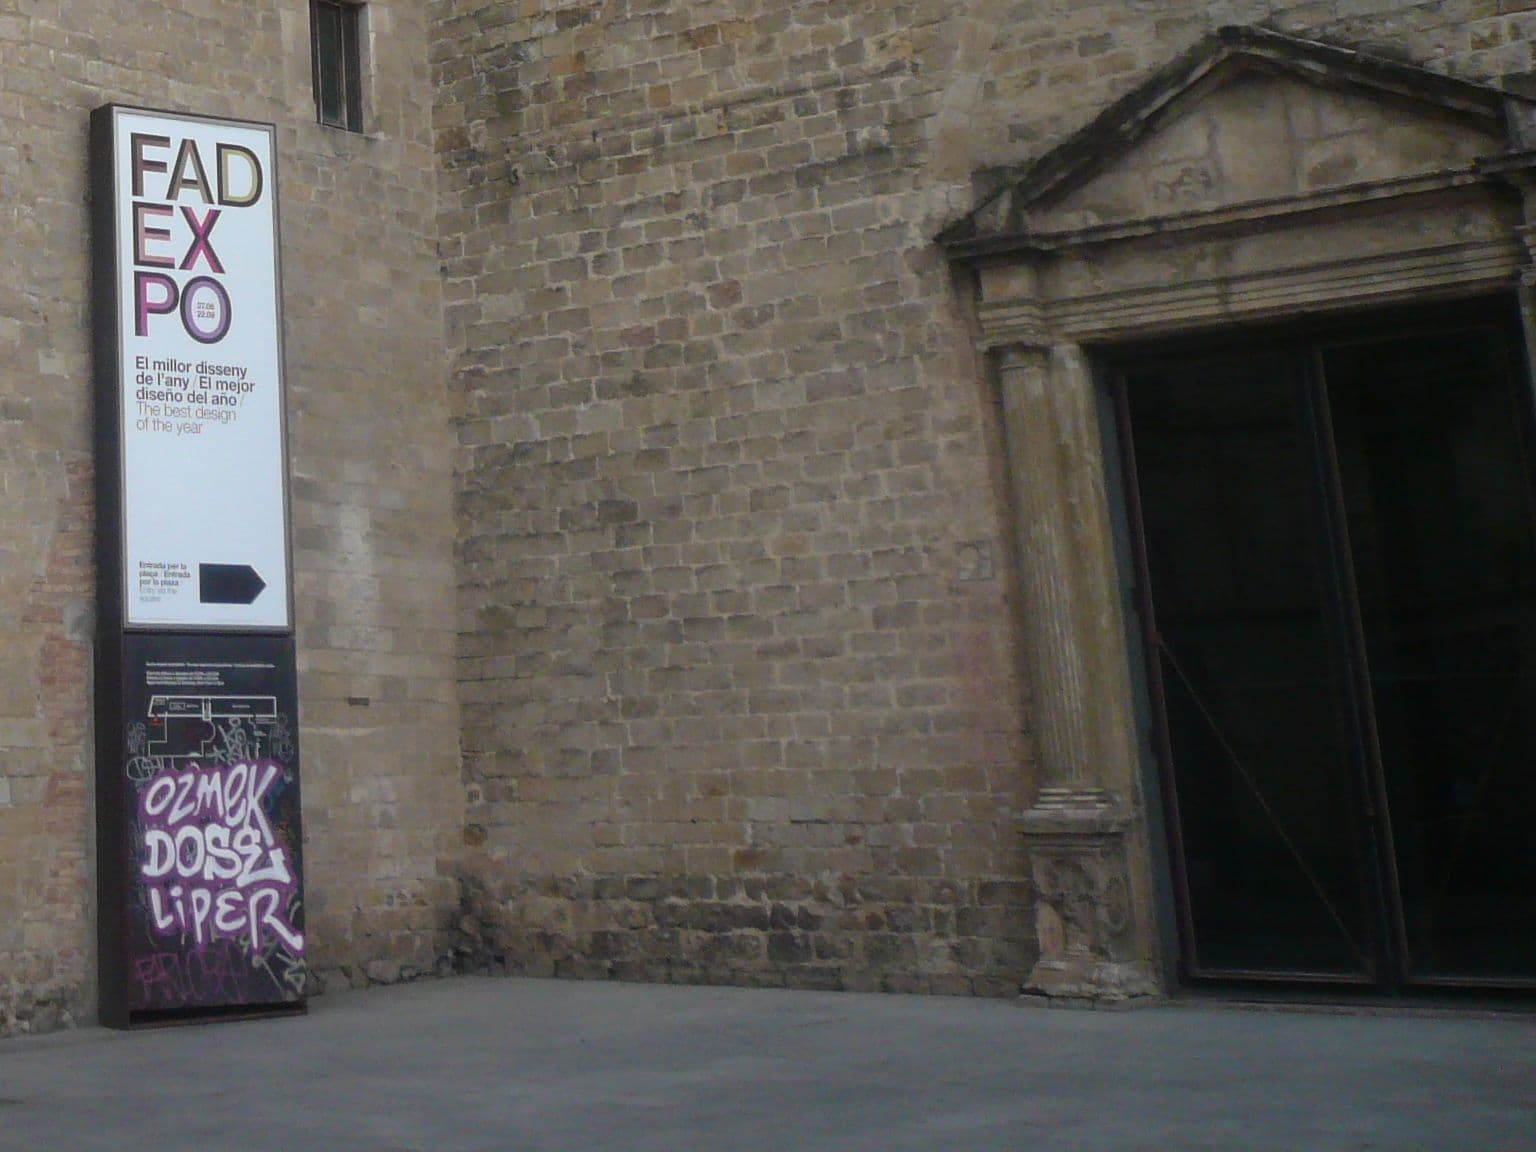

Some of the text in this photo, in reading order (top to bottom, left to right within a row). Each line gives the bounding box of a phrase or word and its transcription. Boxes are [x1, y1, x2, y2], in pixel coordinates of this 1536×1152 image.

[130, 132, 264, 208] FAD
[132, 200, 226, 274] EX
[133, 270, 232, 345] PO
[135, 356, 248, 380] El millor disseny
[136, 372, 154, 385] de
[157, 373, 190, 390] l'any
[199, 376, 212, 389] El
[216, 380, 256, 394] mejor
[136, 387, 183, 402] diseño
[187, 390, 208, 404] del
[211, 392, 238, 406] año
[136, 401, 236, 424] The best design
[136, 416, 203, 436] of the year
